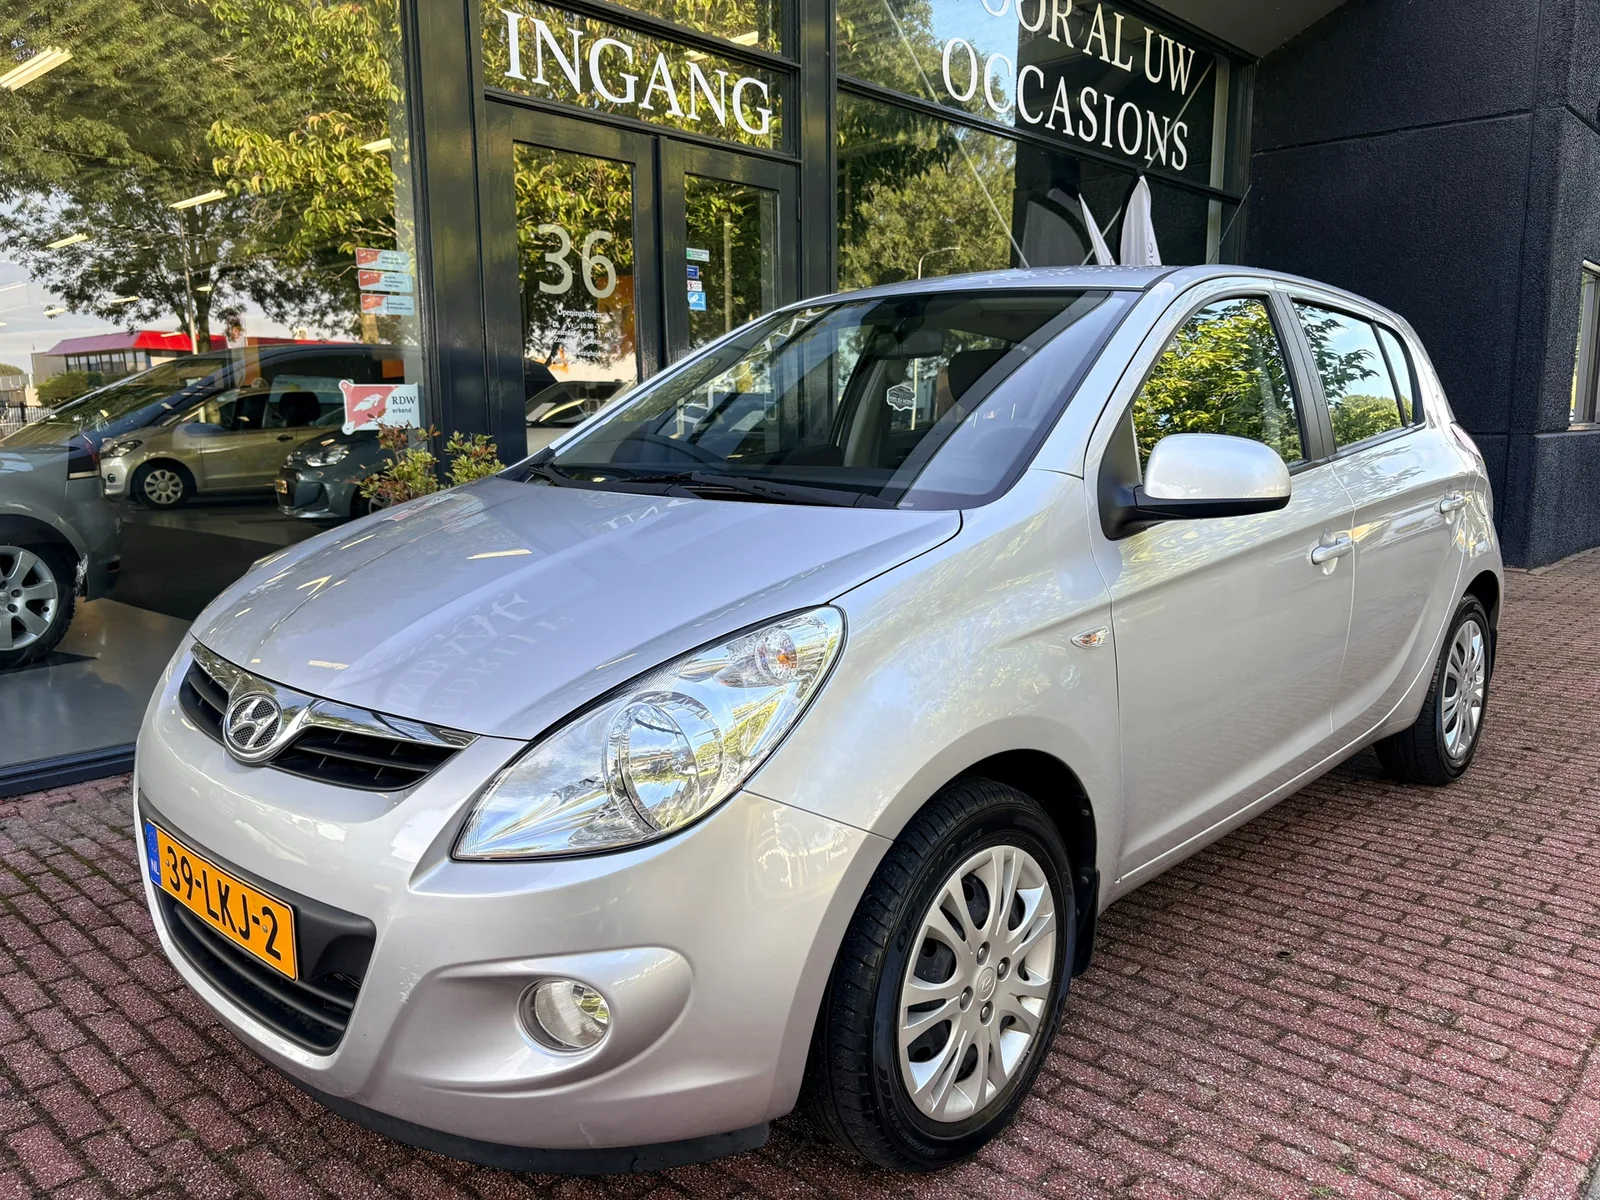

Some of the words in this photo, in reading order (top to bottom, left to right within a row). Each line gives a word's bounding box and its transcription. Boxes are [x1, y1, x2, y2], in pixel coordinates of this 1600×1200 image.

[500, 8, 773, 135] INGANG
[1083, 3, 1133, 72] AL
[1144, 26, 1195, 95] UW
[942, 37, 1188, 171] OCCASIONS
[538, 223, 617, 298] 36
[391, 396, 416, 405] RDW
[150, 858, 160, 875] NL
[167, 845, 281, 962] 39-LKJ-2
